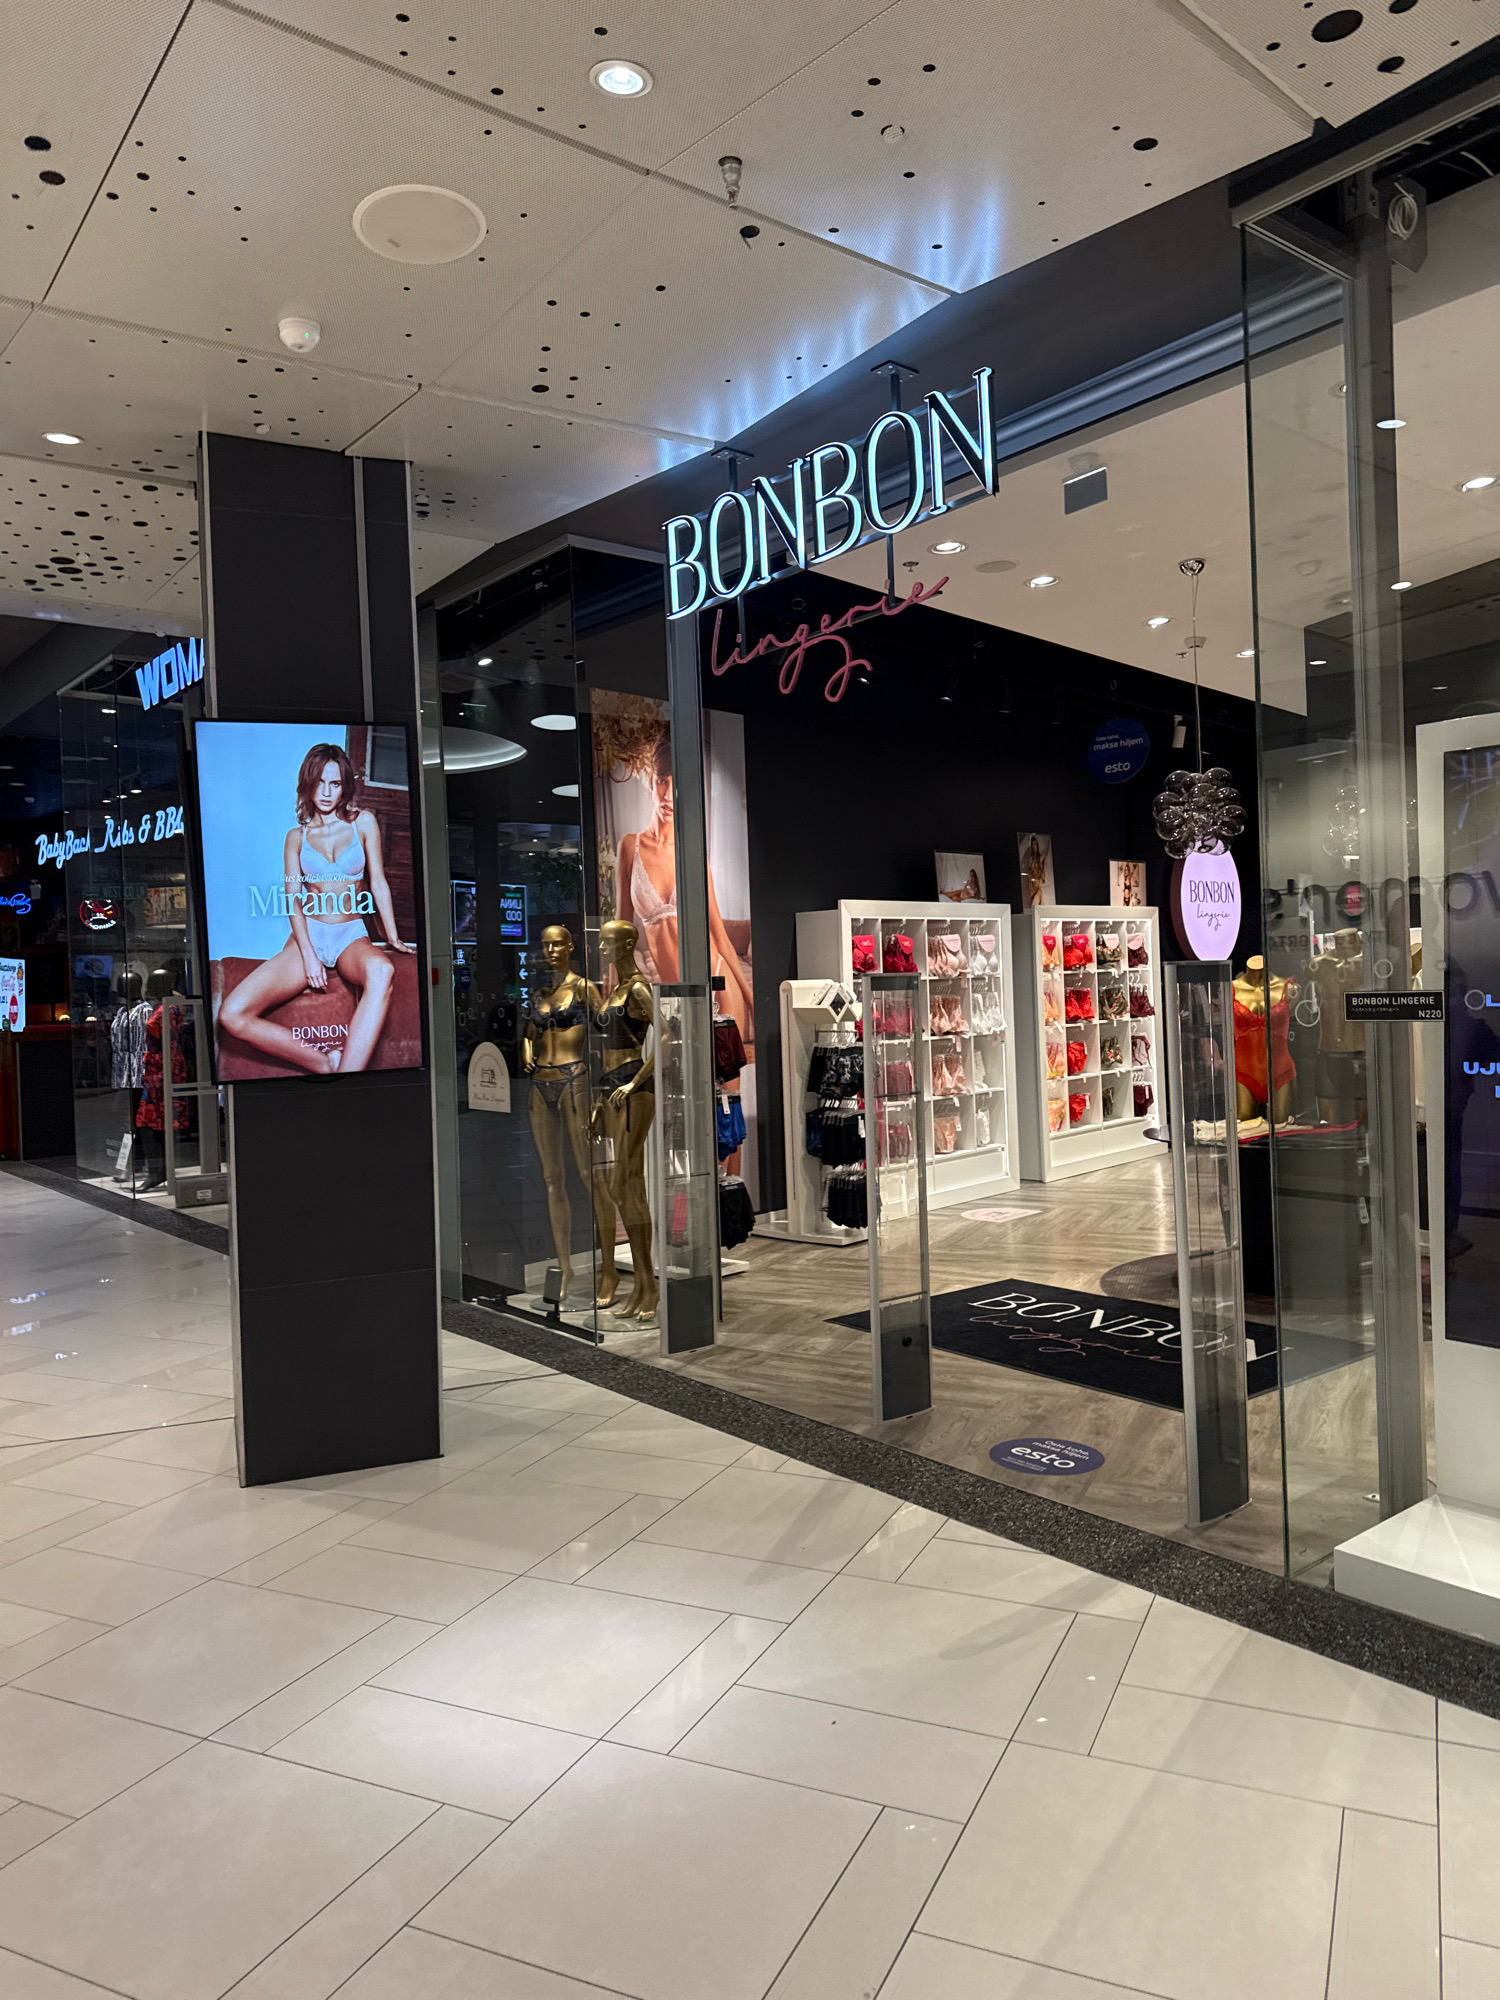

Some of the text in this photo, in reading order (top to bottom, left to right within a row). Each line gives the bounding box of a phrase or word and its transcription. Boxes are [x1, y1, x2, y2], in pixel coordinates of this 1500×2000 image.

[662, 366, 1000, 620] BONBON
[711, 576, 950, 702] lingerie
[1105, 762, 1131, 774] esto
[94, 818, 135, 854] Ribs
[138, 814, 151, 844] &
[249, 883, 376, 917] Miranda
[1189, 880, 1235, 903] BONBON
[1197, 904, 1230, 931] lingerie
[1351, 996, 1435, 1006] BONBON LINGERIE
[1418, 1009, 1442, 1018] N220
[292, 1024, 349, 1040] BONBON
[1463, 1061, 1500, 1075] UJ
[1011, 1446, 1076, 1469] esto
